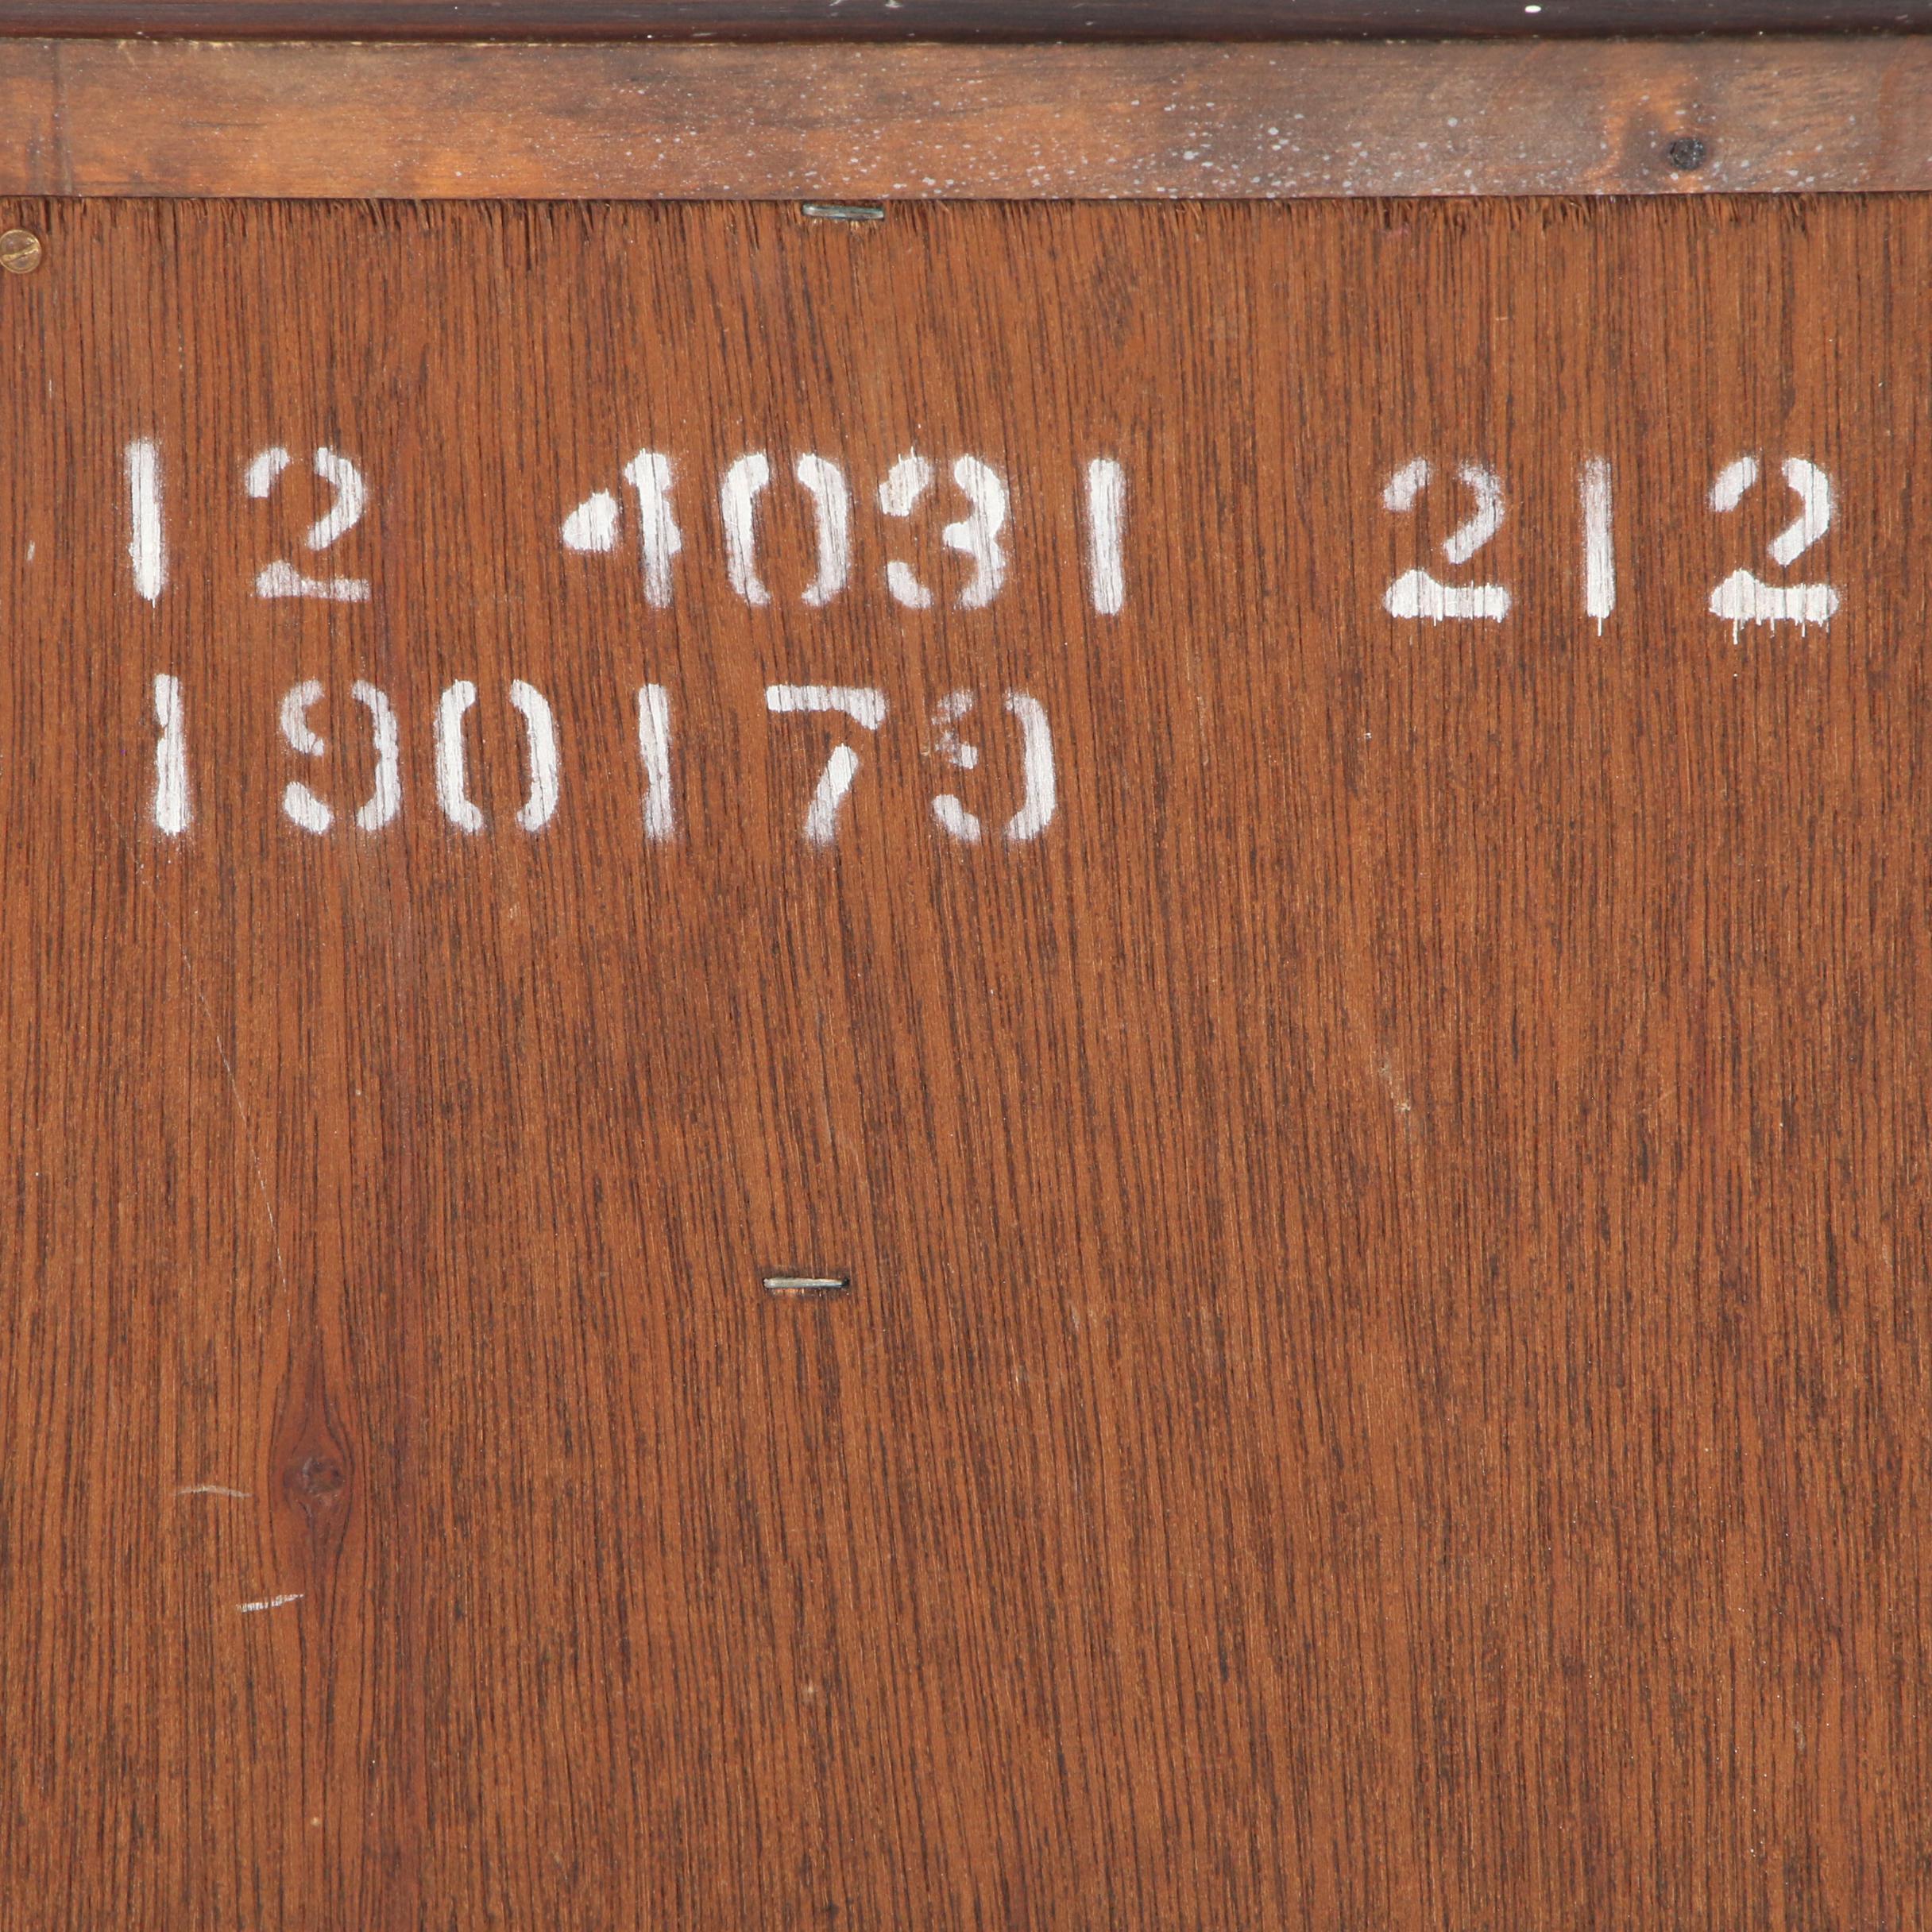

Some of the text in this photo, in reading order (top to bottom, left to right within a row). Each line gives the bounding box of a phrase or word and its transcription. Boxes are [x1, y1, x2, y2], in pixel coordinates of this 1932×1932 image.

[124, 436, 1841, 642] 12 4031 212
